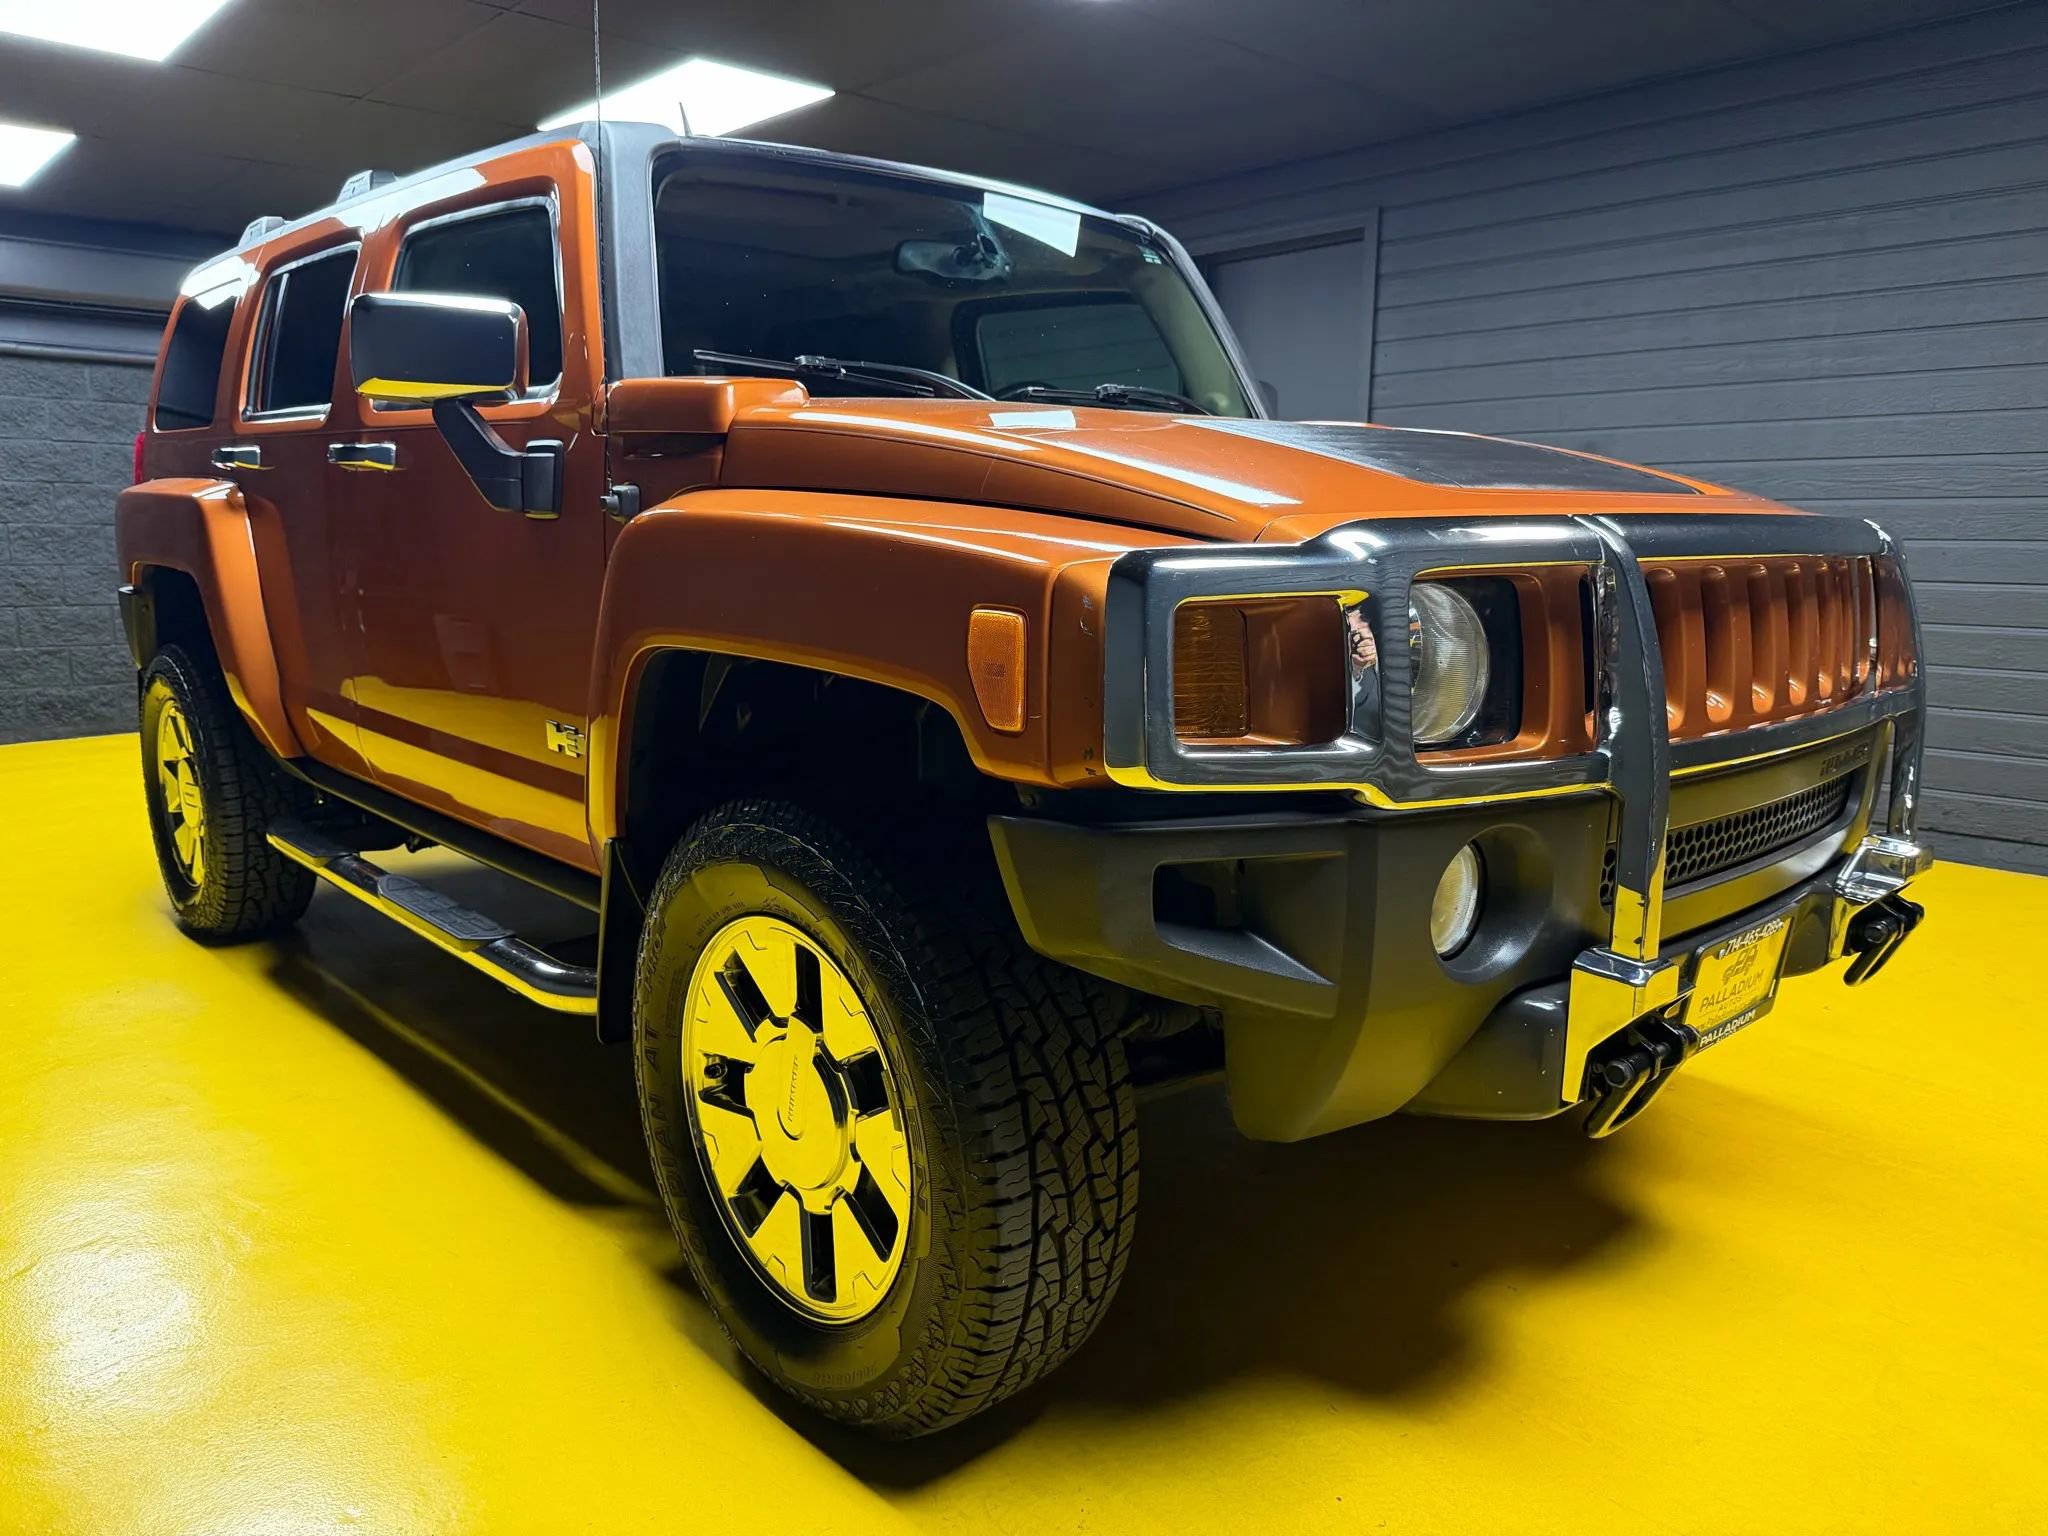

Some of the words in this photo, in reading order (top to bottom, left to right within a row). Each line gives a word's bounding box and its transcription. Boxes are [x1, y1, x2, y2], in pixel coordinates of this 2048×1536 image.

[1699, 969, 1764, 1012] PALLADIUM
[1700, 1009, 1756, 1047] PALLADIUM
[844, 945, 928, 1215] NEXEN
